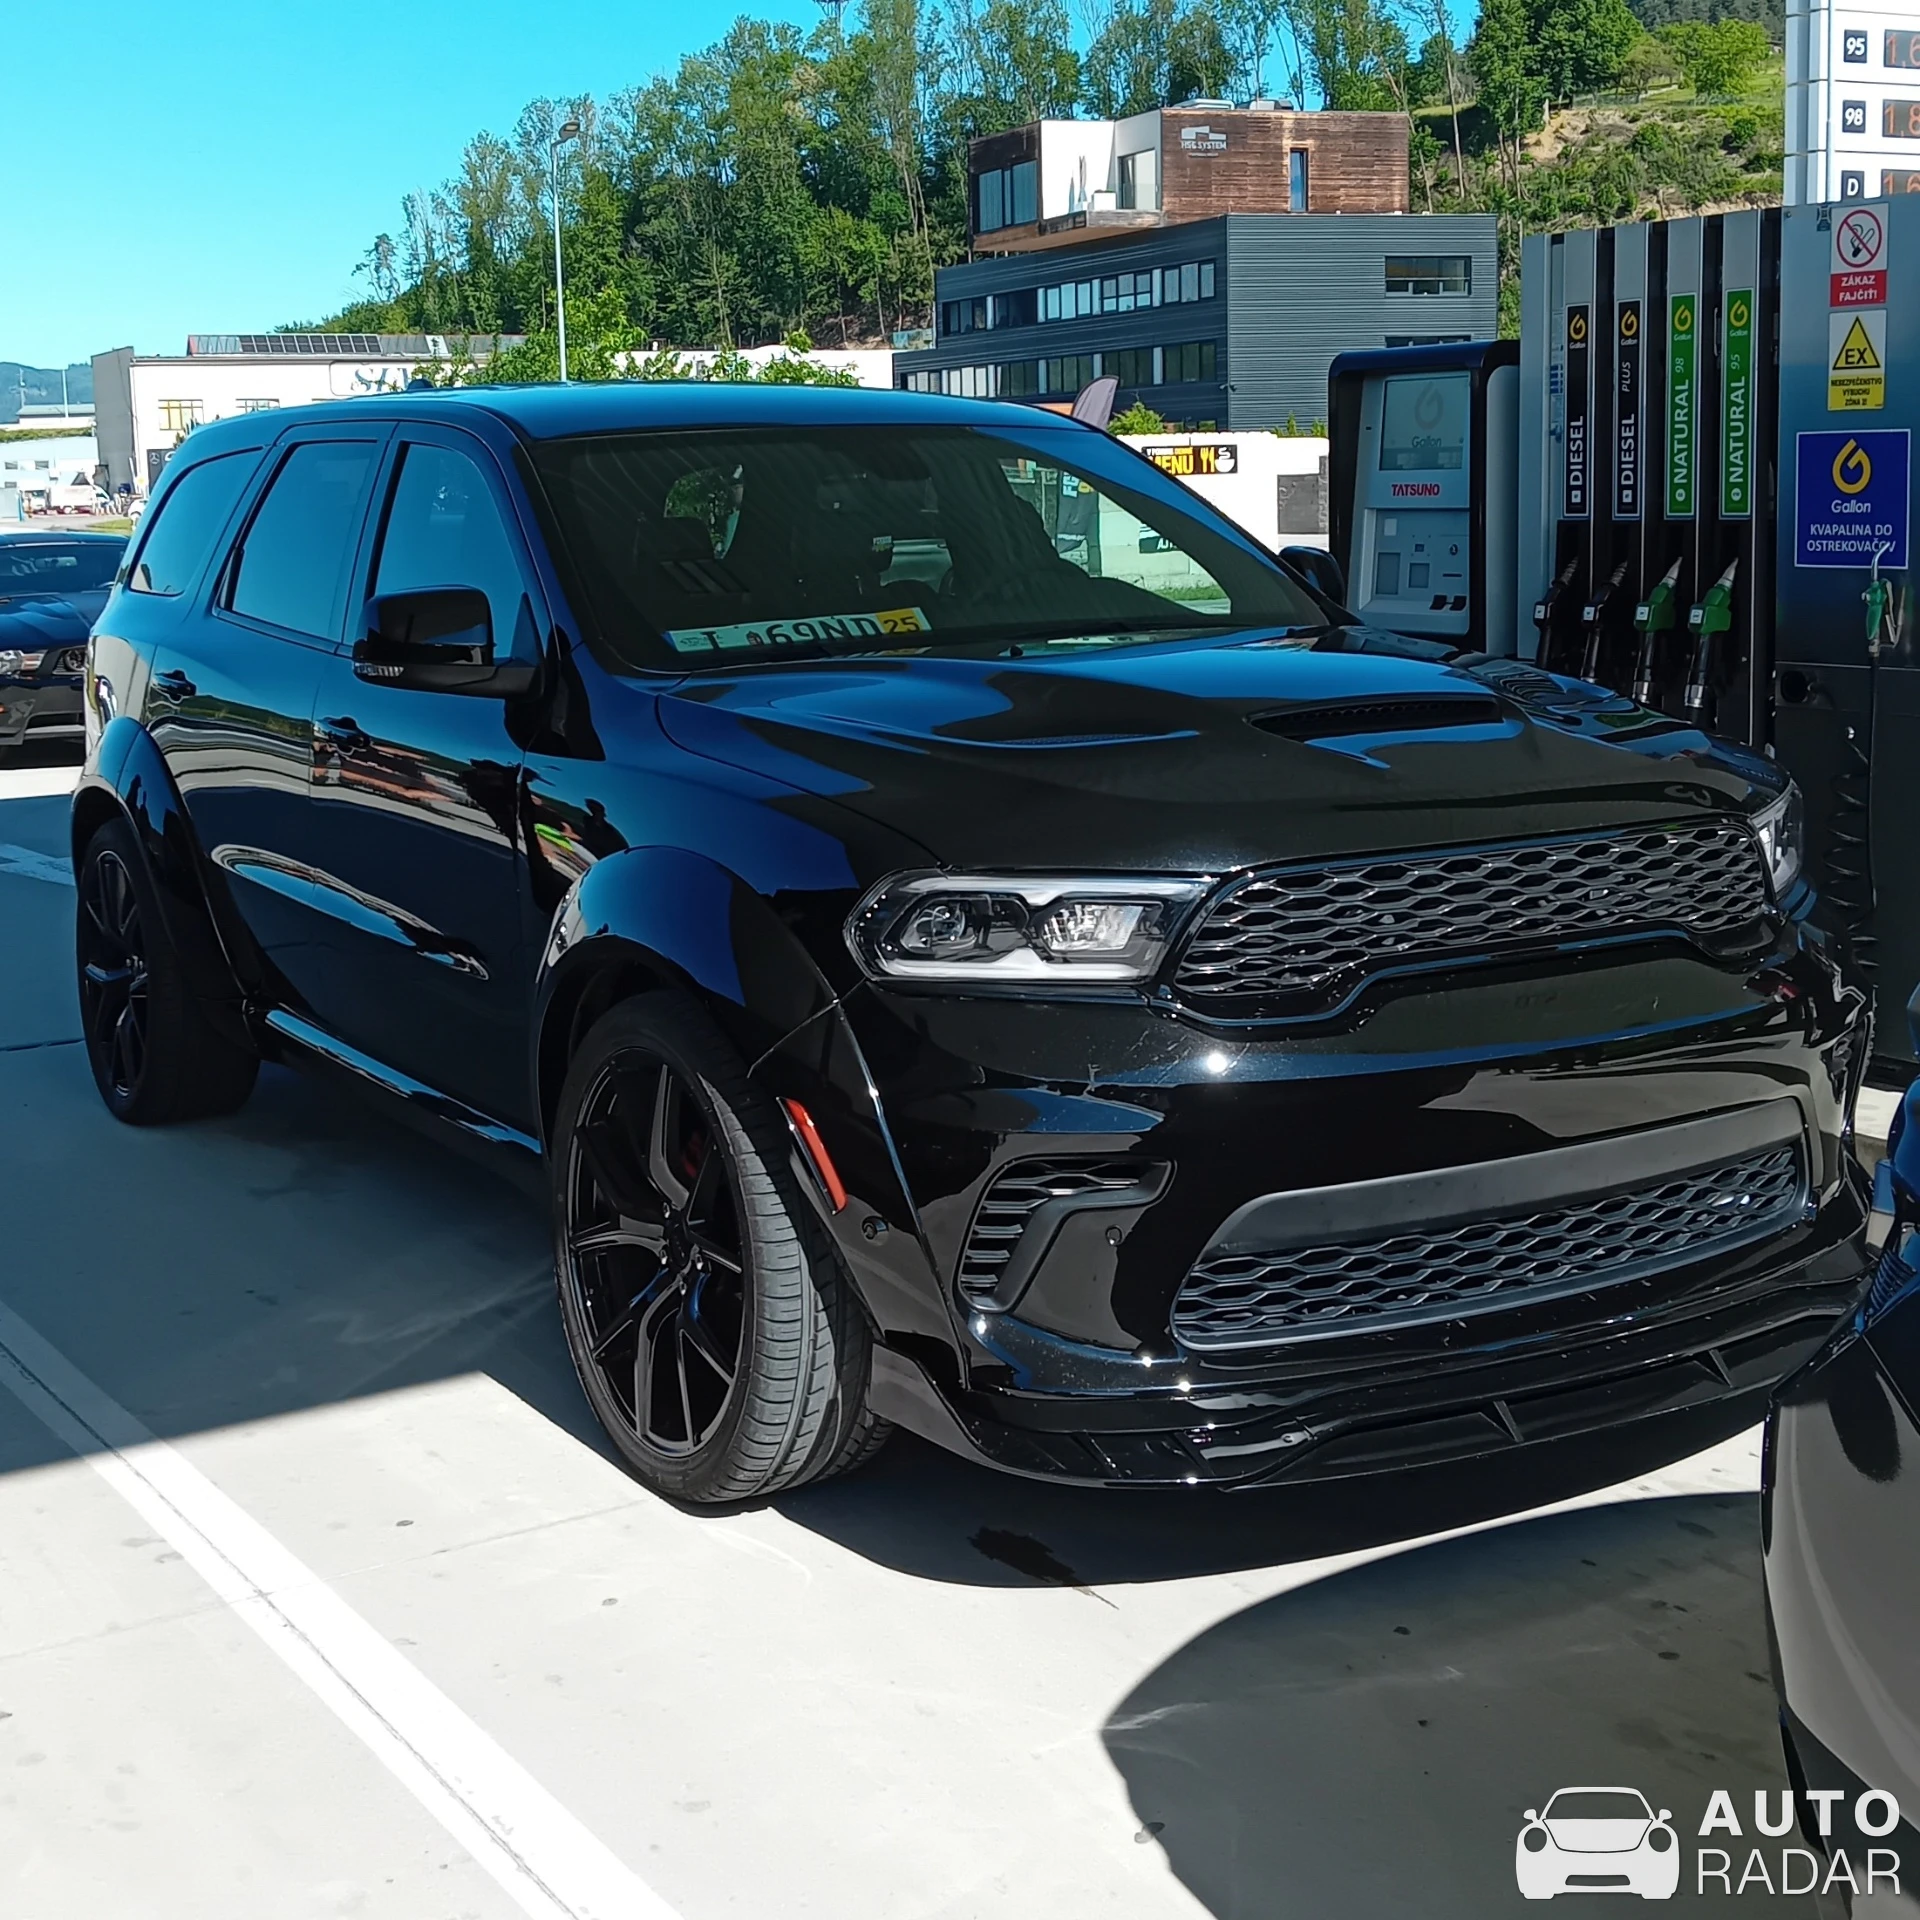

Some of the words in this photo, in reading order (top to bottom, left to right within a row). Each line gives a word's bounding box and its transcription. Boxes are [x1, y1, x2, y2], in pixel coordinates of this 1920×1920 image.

[1846, 37, 1865, 55] 95
[1845, 107, 1863, 126] 98
[1847, 178, 1859, 196] D
[1841, 274, 1875, 287] ZÁKAZ
[1675, 357, 1685, 373] 98
[1730, 354, 1741, 370] 95
[1845, 348, 1868, 365] EX
[1621, 361, 1631, 393] PLUS
[1673, 379, 1689, 484] NATURAL
[1729, 375, 1745, 483] NATURAL
[1411, 435, 1442, 448] Gallon
[1621, 413, 1635, 485] DIESEL
[1570, 415, 1583, 486] DIESEL
[1391, 483, 1441, 496] TATSUNO
[1831, 499, 1872, 513] Gallon
[1810, 524, 1872, 536] KVAPALINA
[1875, 524, 1893, 536] DO
[883, 616, 921, 633] 25
